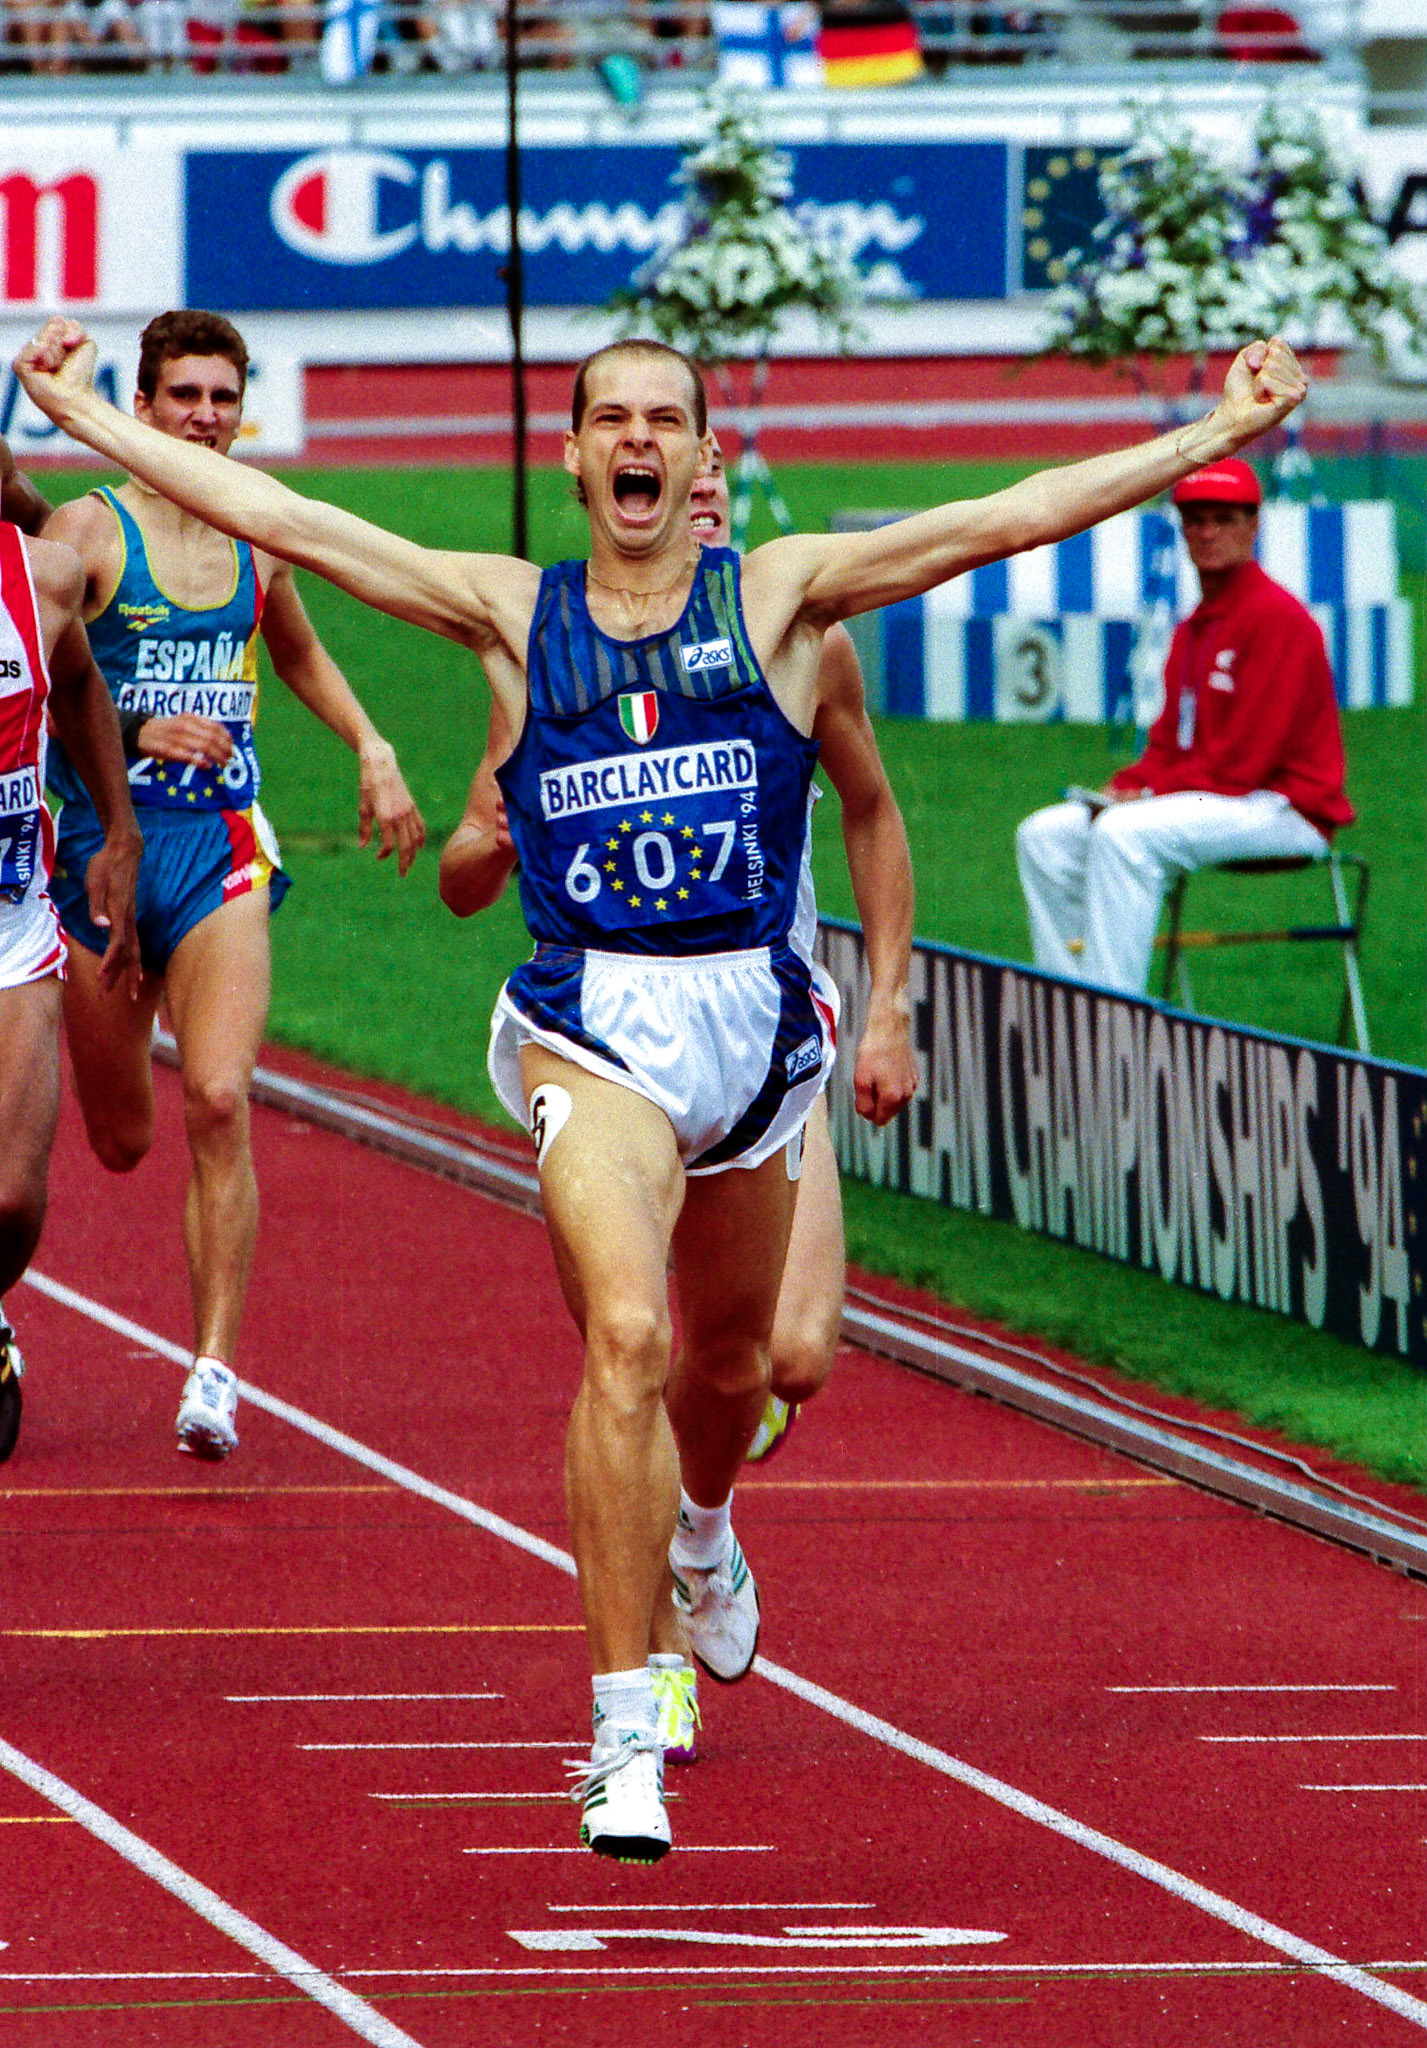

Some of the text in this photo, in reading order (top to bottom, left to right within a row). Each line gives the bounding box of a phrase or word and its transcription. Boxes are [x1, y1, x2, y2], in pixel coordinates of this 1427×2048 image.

[135, 631, 246, 681] ESPAÑA
[1015, 637, 1050, 707] 3
[544, 748, 754, 814] BARCLAYCARD
[565, 820, 737, 903] 607
[740, 791, 766, 900] HELSINKI '94
[1001, 967, 1327, 1329] CHAMPIONSHIPS
[1337, 1062, 1410, 1355] '94
